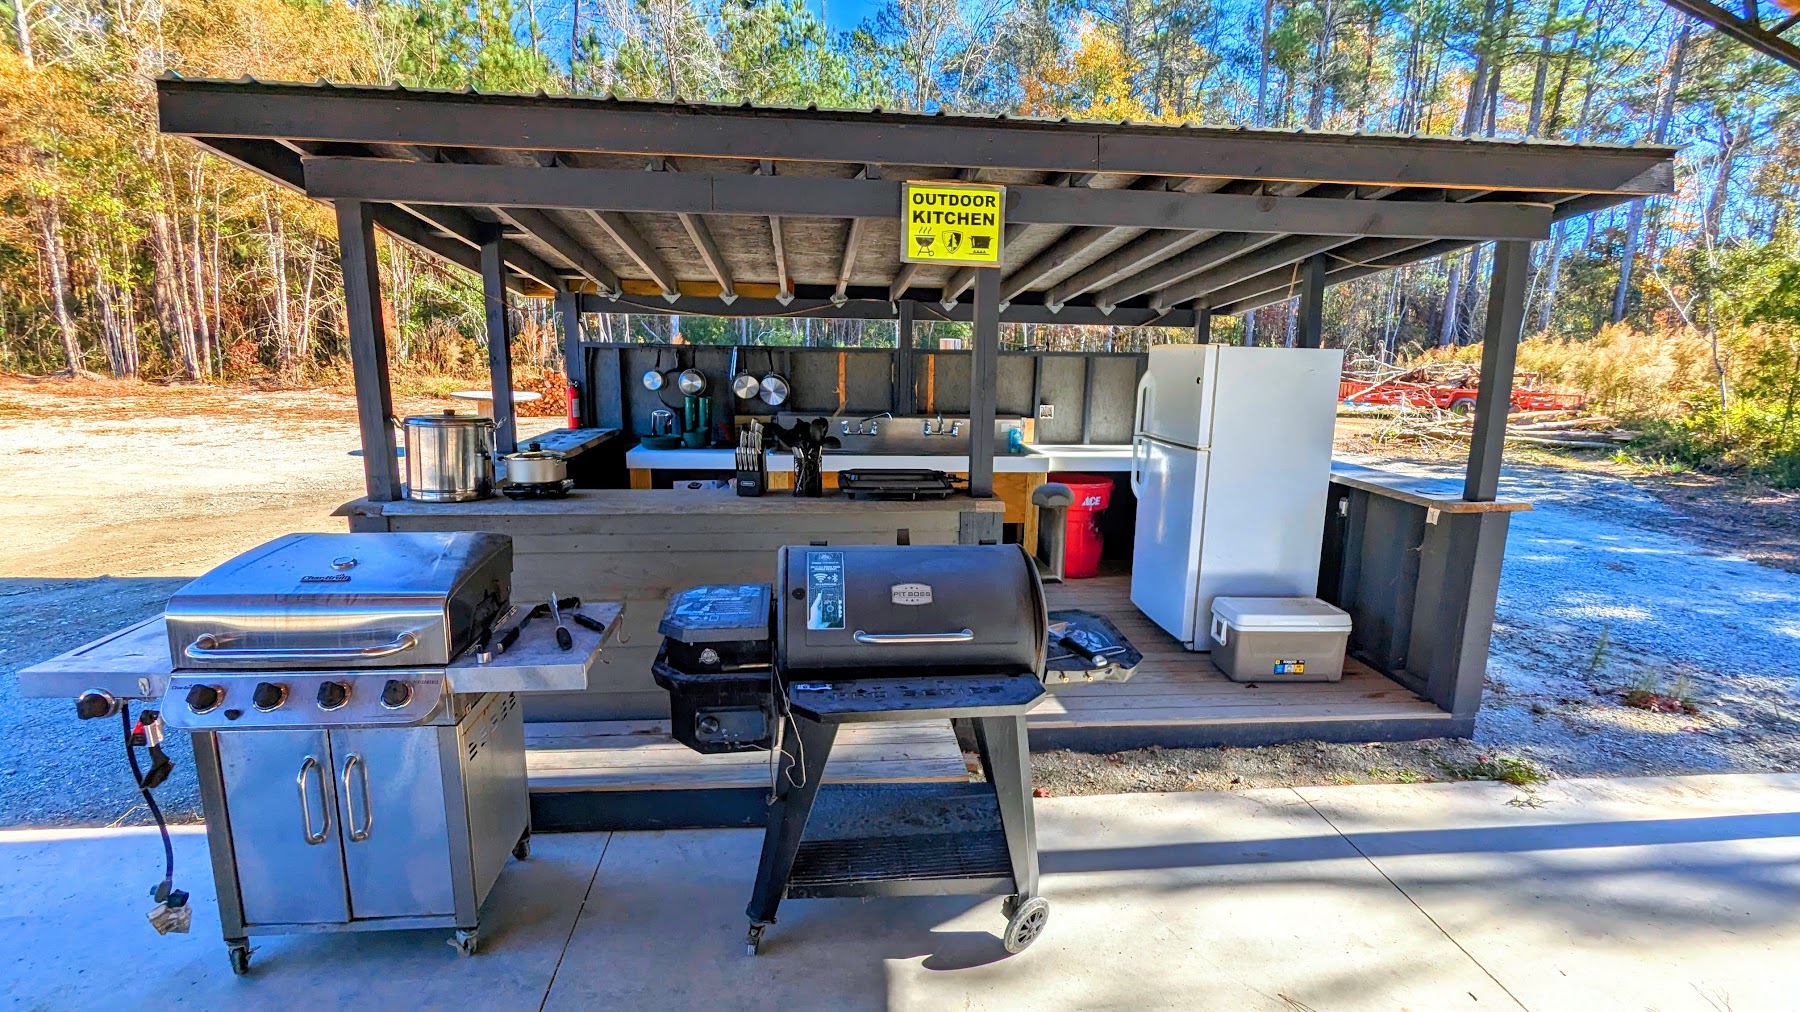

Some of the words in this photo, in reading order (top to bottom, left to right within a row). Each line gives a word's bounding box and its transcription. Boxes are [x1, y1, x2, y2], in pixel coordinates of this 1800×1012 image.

[912, 193, 996, 208] OUTDOOR
[912, 210, 995, 226] KITCHEN
[1081, 496, 1101, 506] ACE
